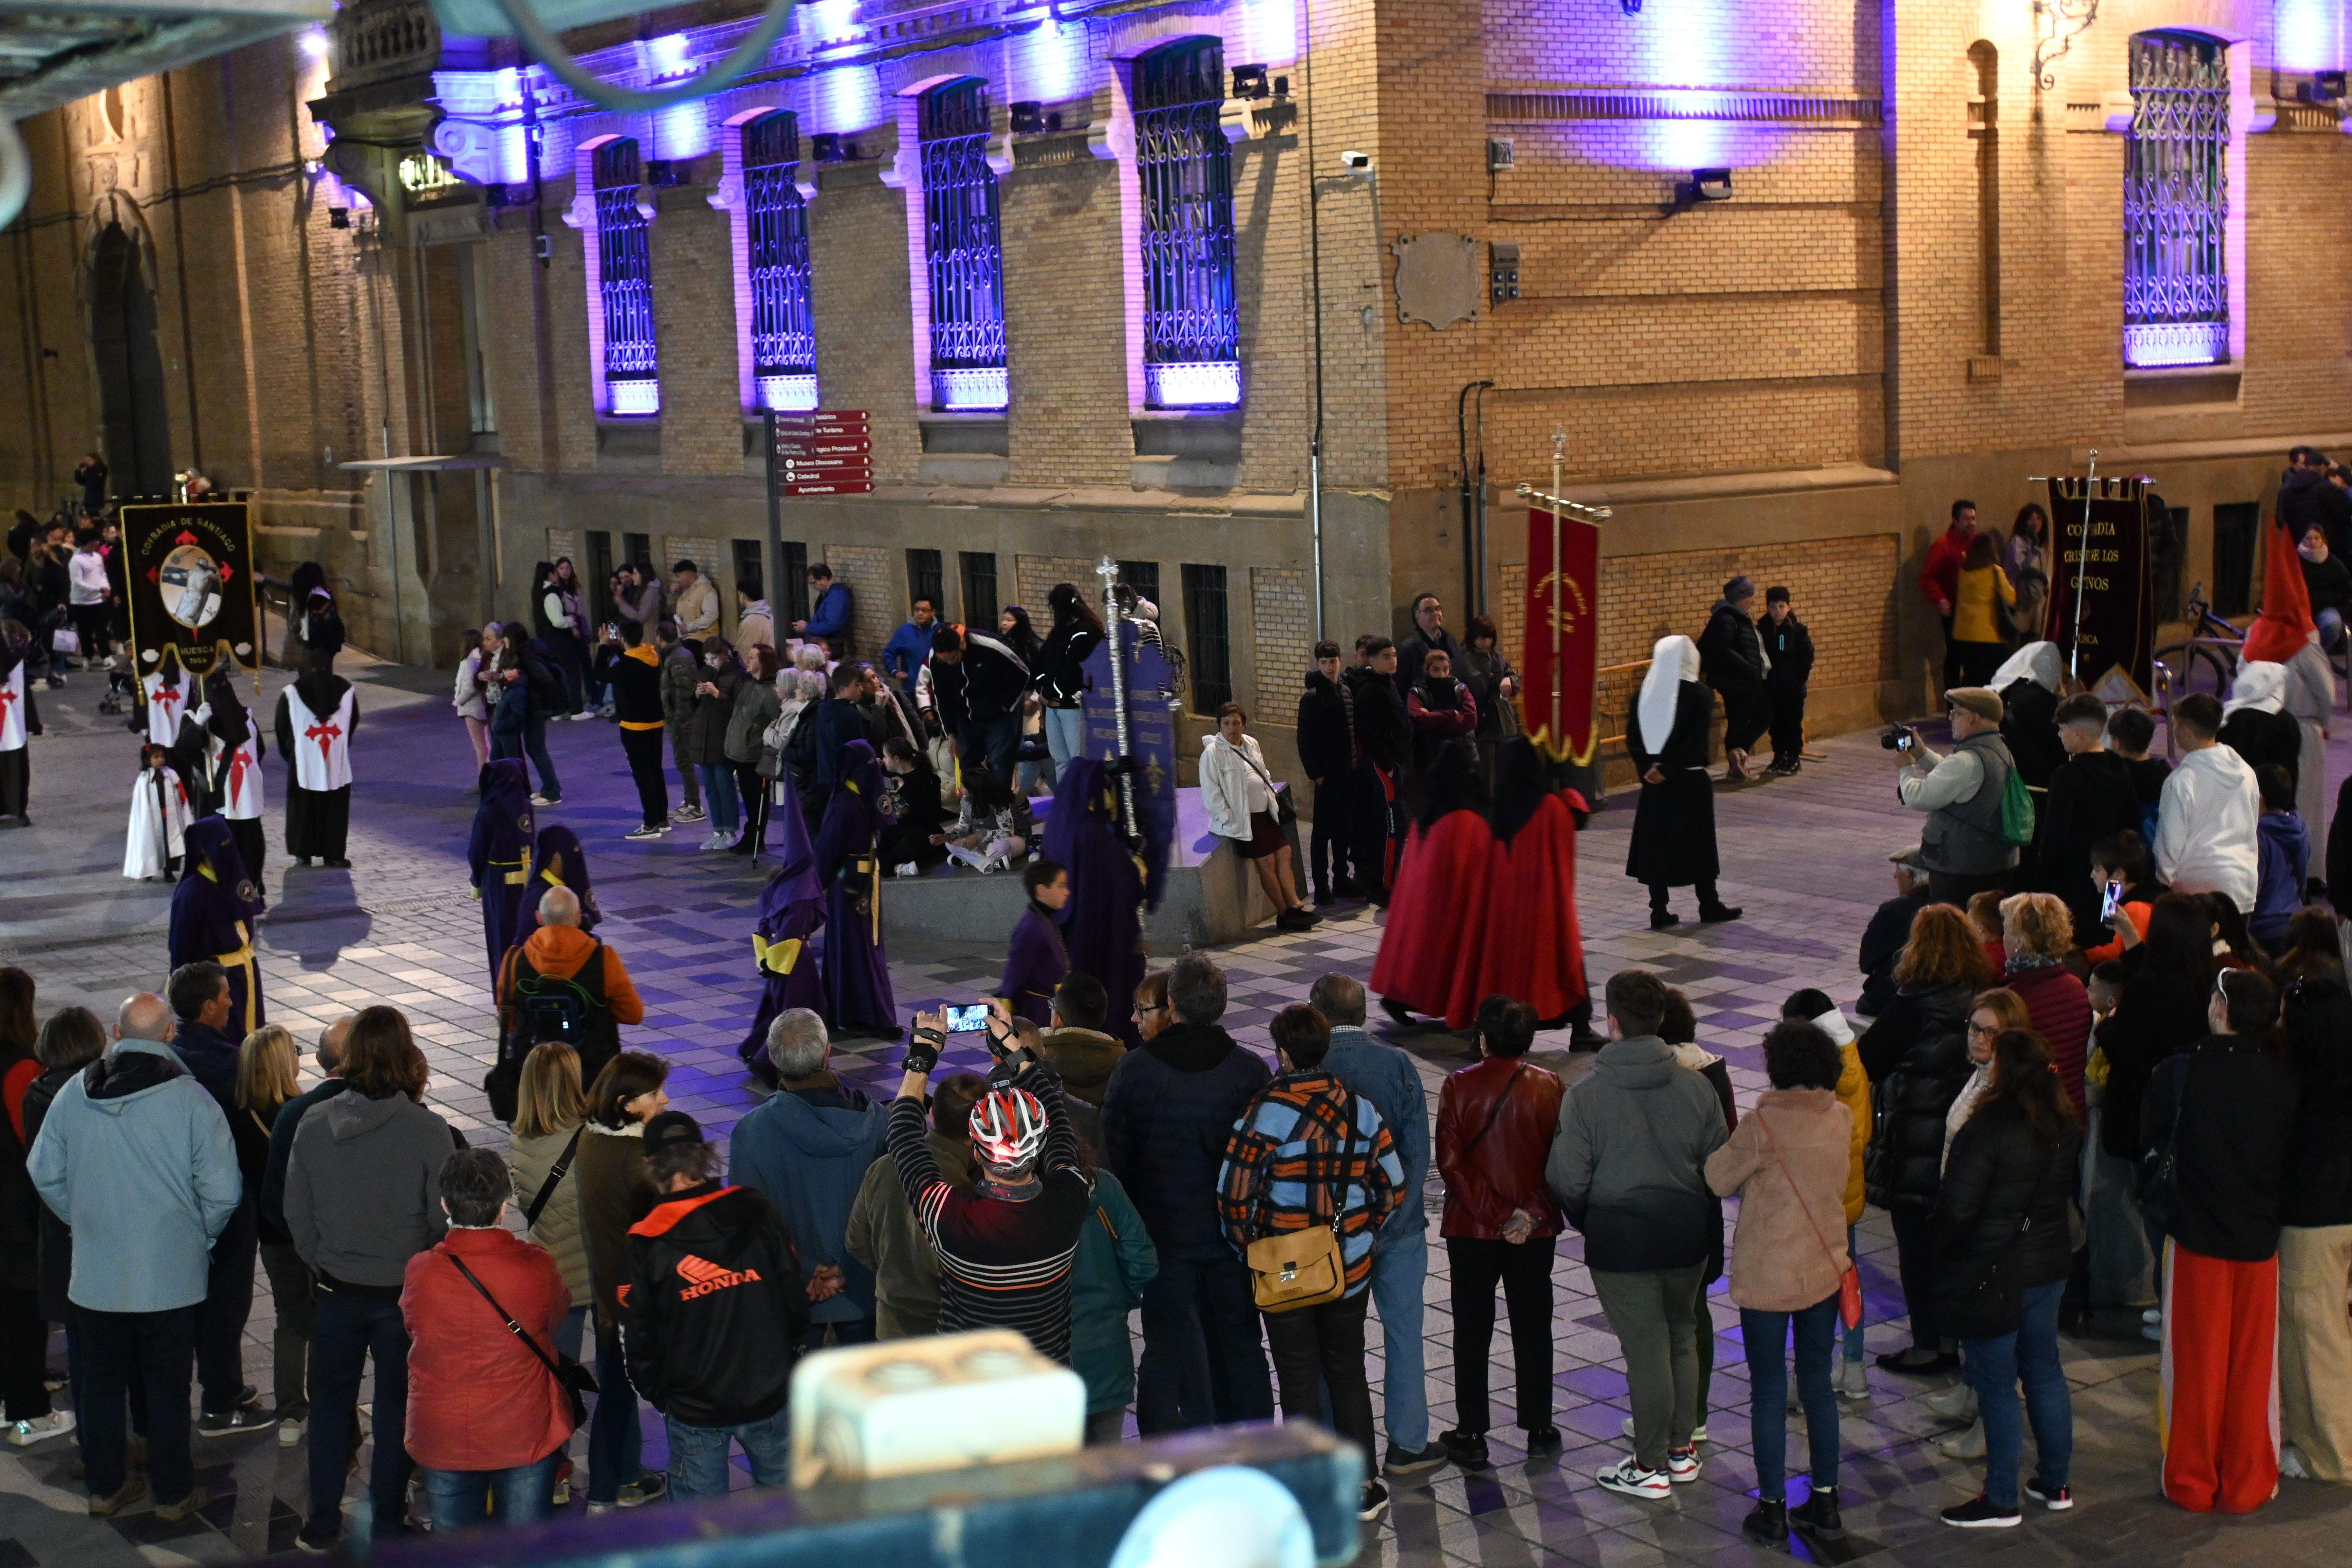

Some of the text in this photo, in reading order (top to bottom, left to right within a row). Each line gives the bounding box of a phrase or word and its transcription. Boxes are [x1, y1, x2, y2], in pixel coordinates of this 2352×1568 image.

[180, 517, 193, 526] DE
[197, 517, 236, 552] SANTIAGO
[2102, 549, 2119, 562] LOS
[180, 645, 214, 655] HUESCA
[679, 1269, 762, 1301] HONDA
